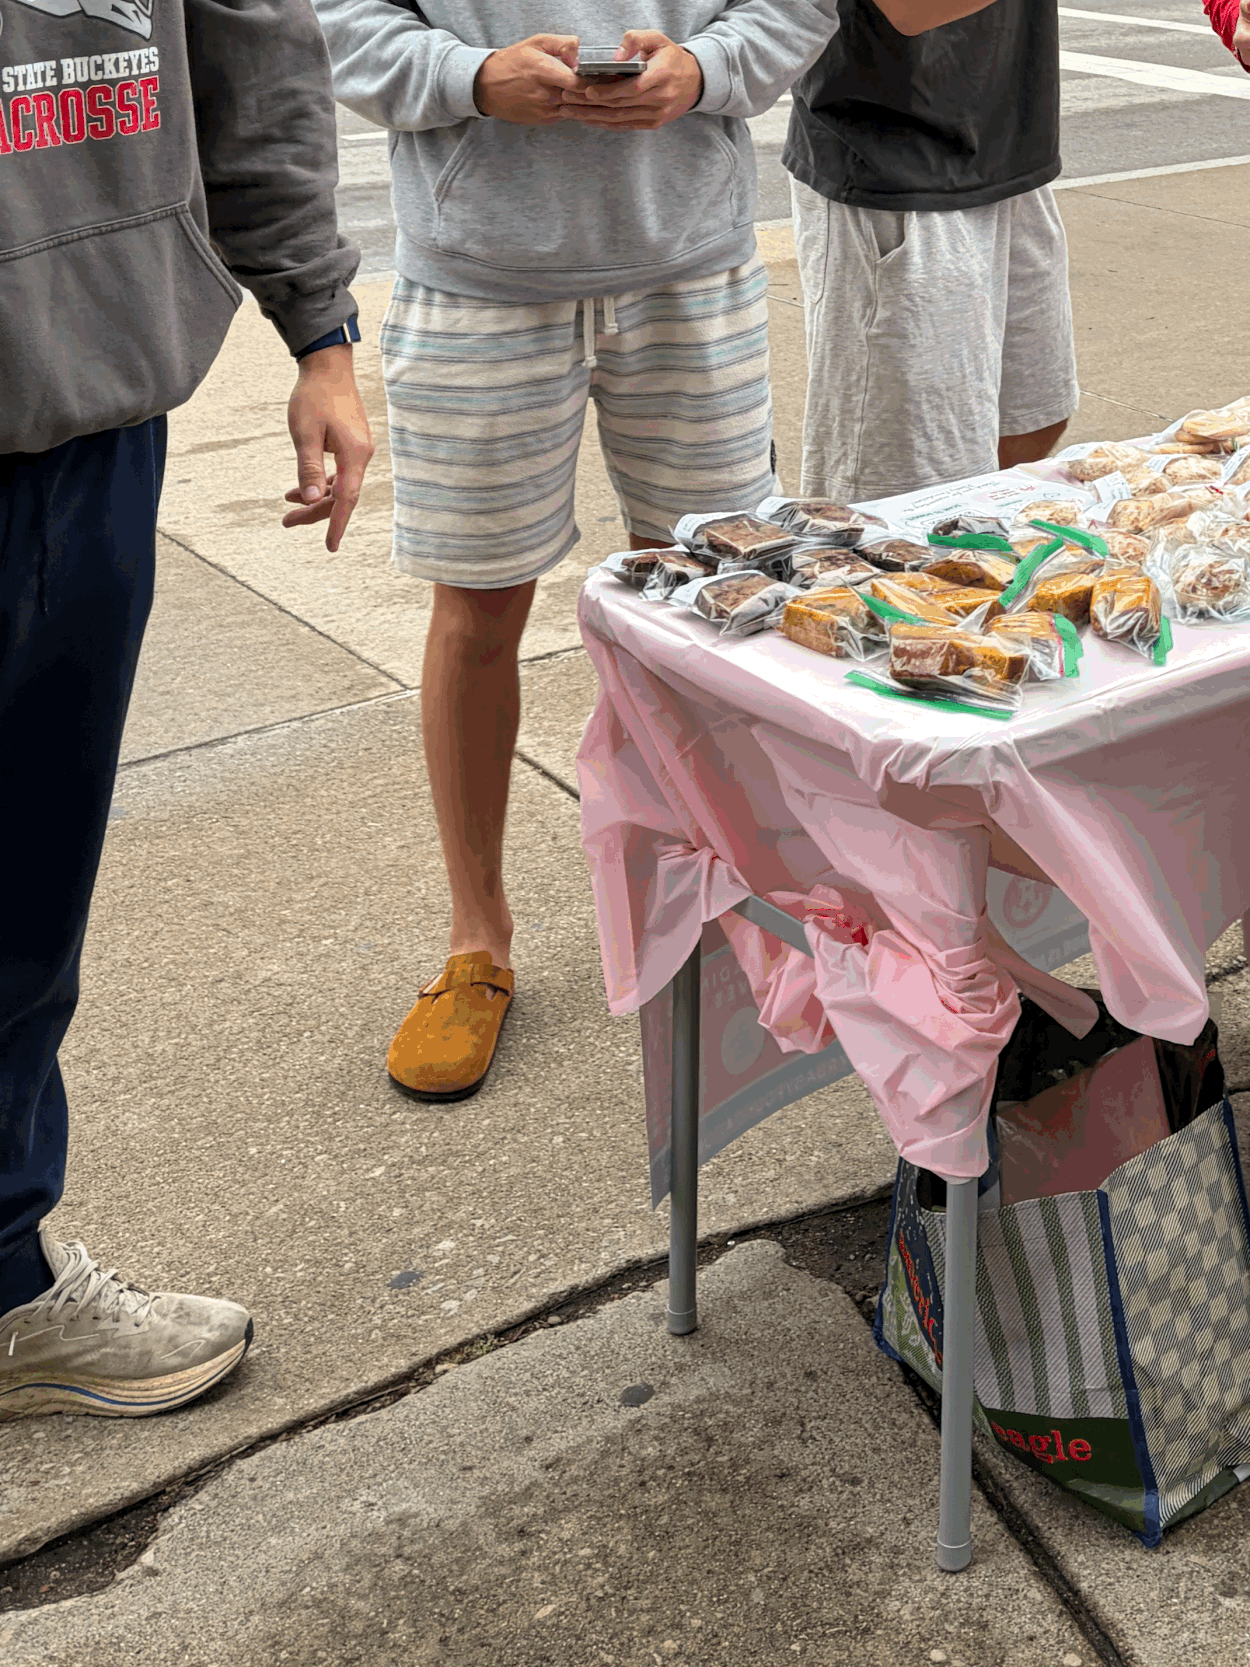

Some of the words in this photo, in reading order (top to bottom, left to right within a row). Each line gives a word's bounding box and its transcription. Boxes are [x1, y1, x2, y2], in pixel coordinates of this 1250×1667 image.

[2, 60, 58, 93] STATE
[60, 46, 160, 85] BUCKEYES
[990, 1421, 1092, 1465] eagle
